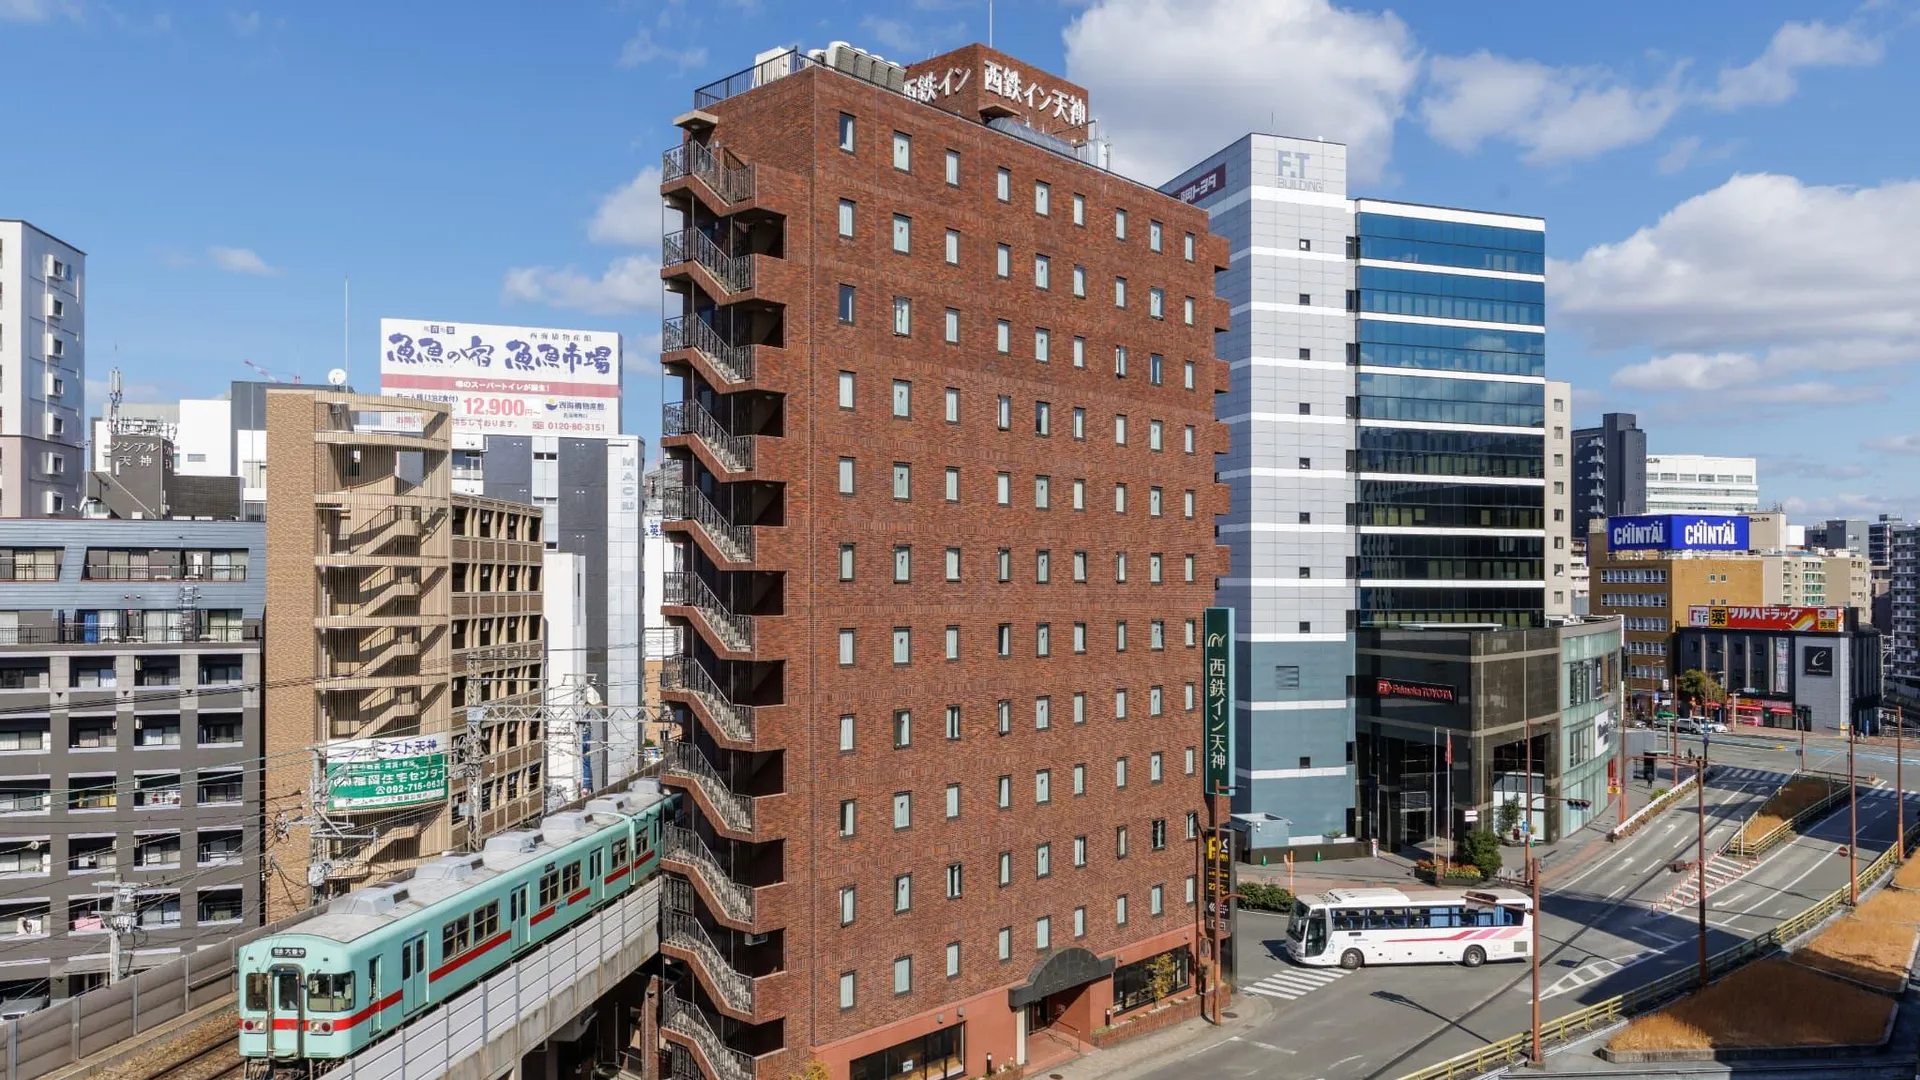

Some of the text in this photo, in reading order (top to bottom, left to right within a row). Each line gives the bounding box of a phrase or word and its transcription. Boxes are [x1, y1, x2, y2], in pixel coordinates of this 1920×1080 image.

[983, 60, 1086, 125] 西鉄イン天神
[1278, 178, 1324, 193] BUILDING
[505, 339, 612, 375] 魚魚市場
[111, 441, 160, 453] ソシアル
[1684, 519, 1736, 545] CHINTAI
[1711, 607, 1801, 625] 薬 ツルハドラッグ
[1421, 687, 1453, 700] TOYOTA
[1209, 657, 1227, 770] 西鉄イン天神
